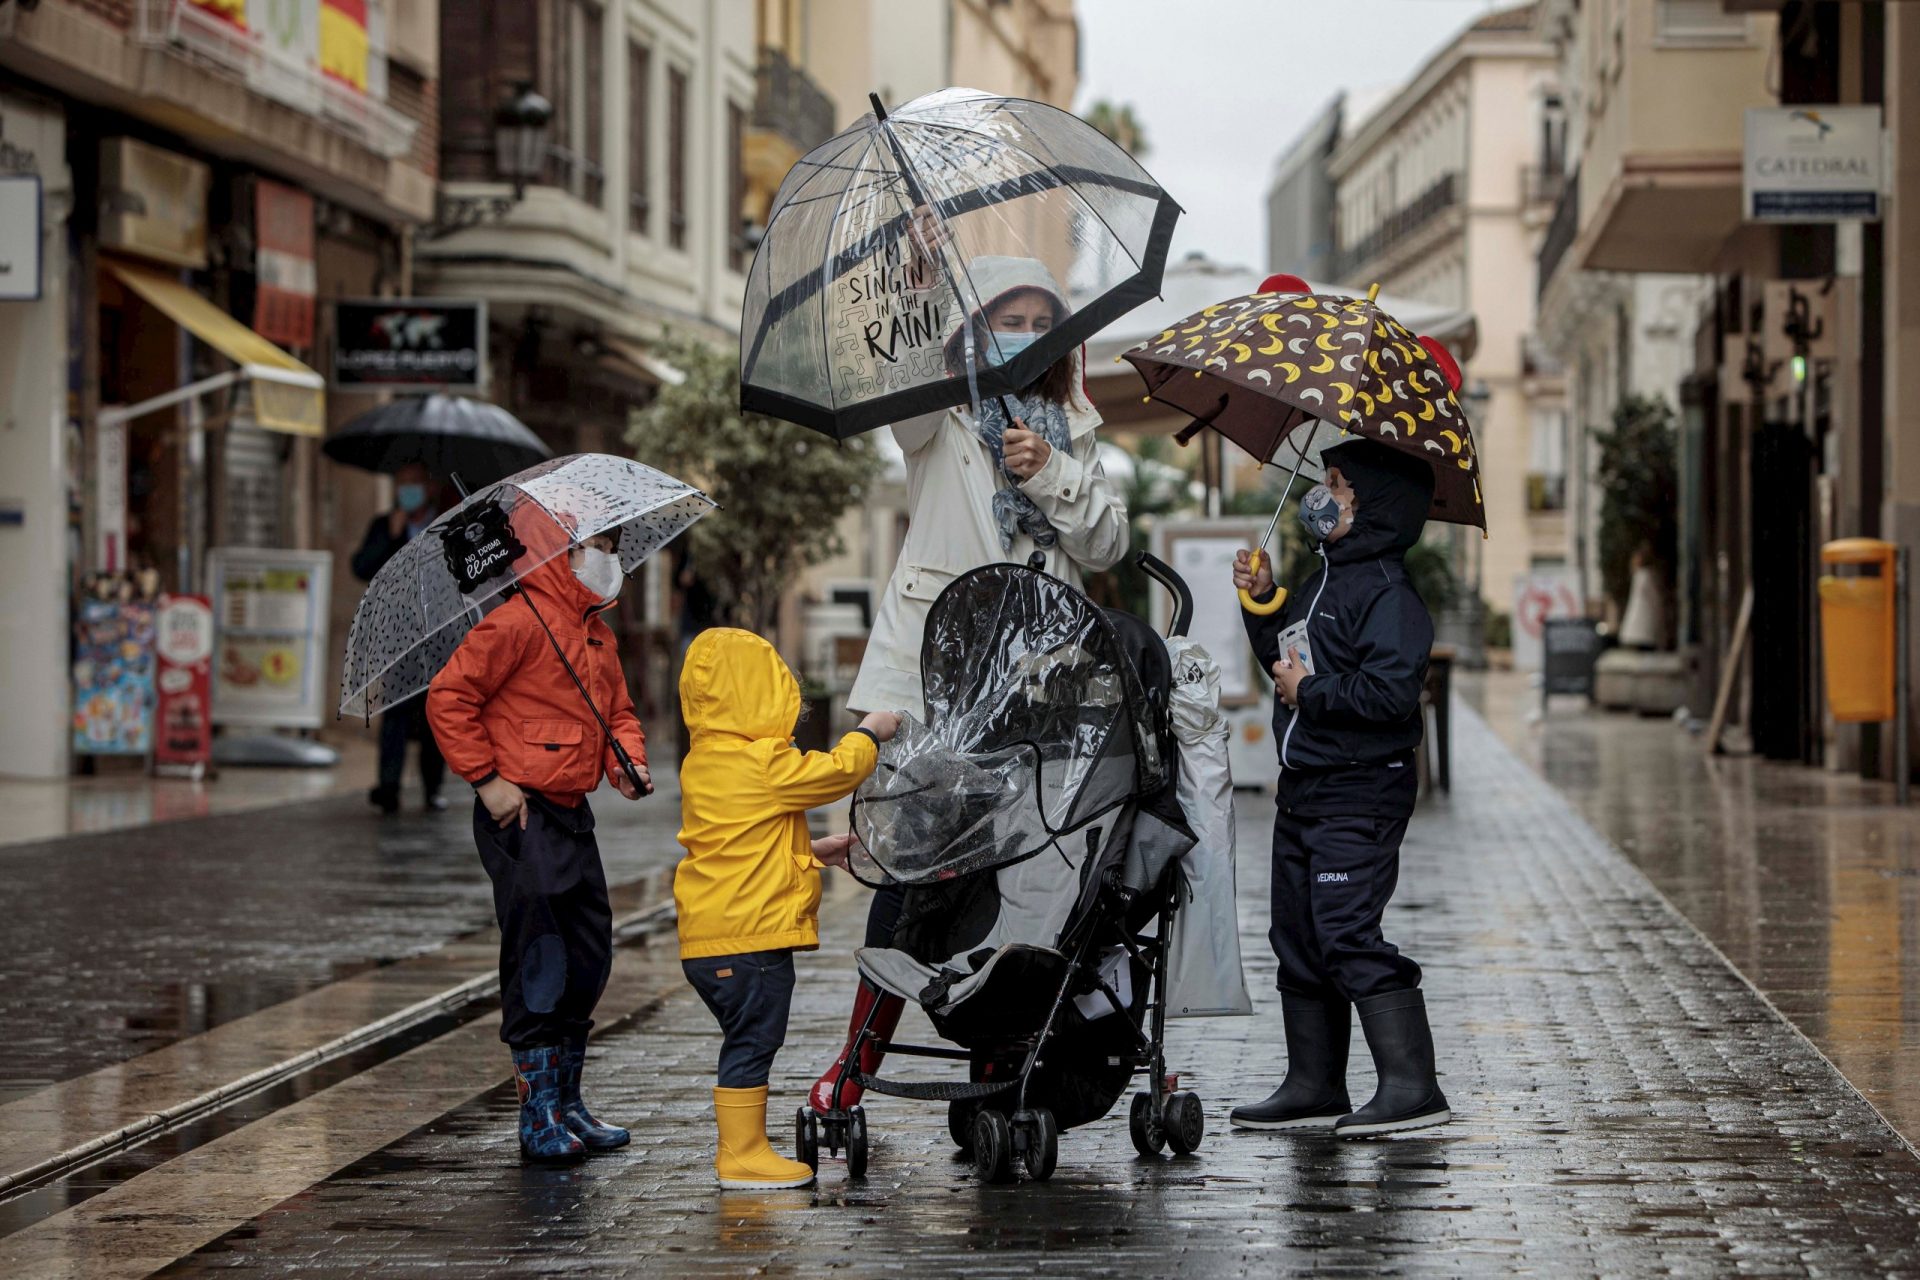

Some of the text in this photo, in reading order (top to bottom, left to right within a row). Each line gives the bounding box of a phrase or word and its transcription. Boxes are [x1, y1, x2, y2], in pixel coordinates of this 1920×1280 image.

[1755, 155, 1870, 177] CATEDRAL
[871, 241, 901, 271] I'M
[850, 256, 928, 304] SINGIN'
[876, 293, 921, 318] IN THE
[864, 301, 942, 362] RAIN!
[464, 538, 501, 565] NO DRAMA
[466, 548, 509, 579] llama
[1317, 872, 1349, 883] VEDRUNA
